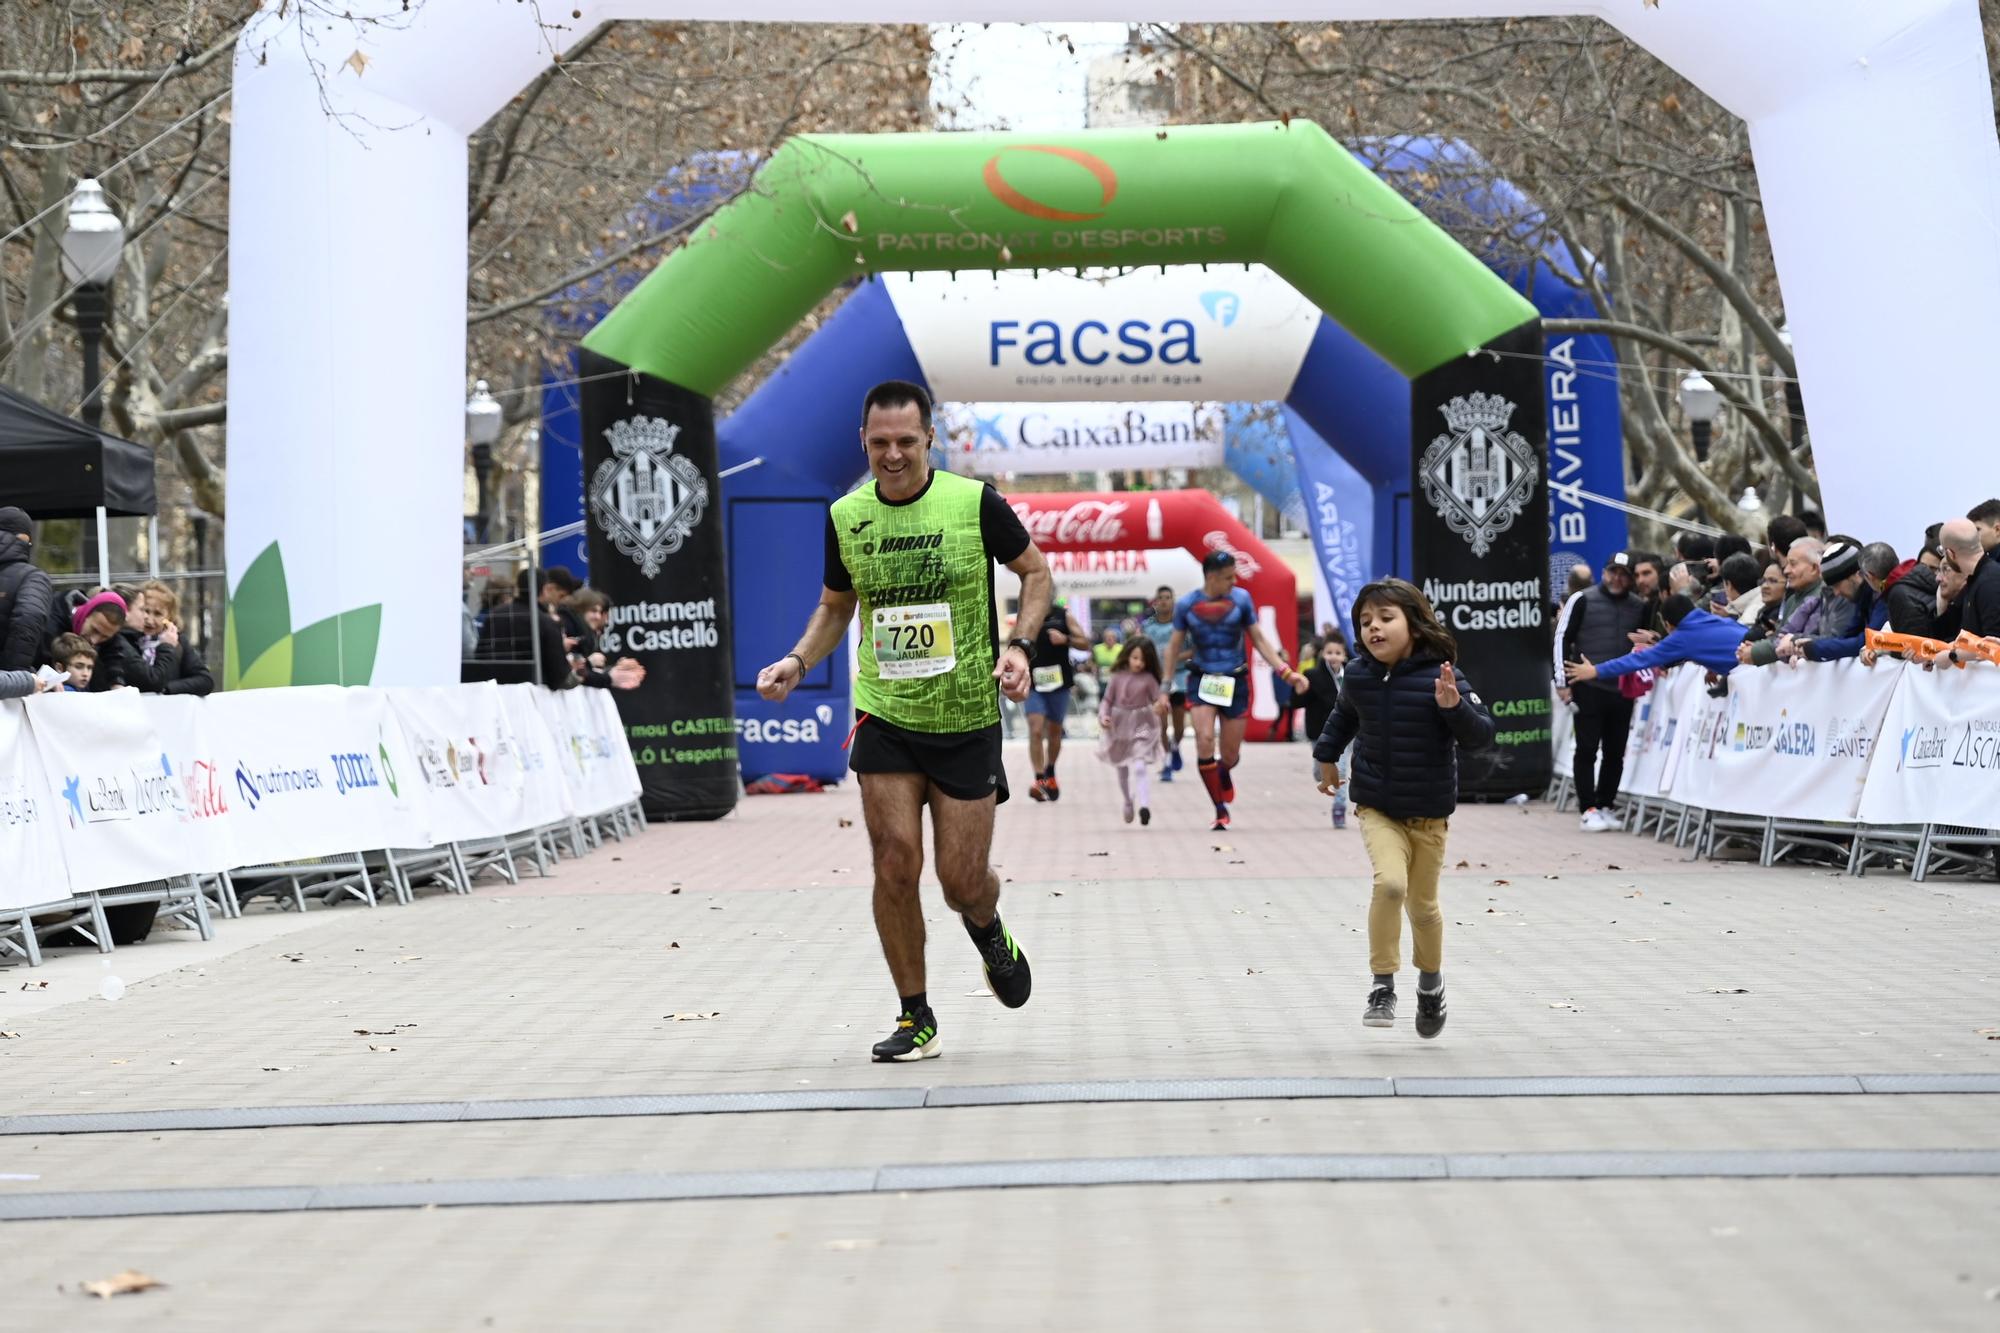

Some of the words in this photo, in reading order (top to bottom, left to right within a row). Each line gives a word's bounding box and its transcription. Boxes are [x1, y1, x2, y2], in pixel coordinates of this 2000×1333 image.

[877, 231, 1040, 251] PATRONAT
[1052, 227, 1226, 249] D'ESPORTS
[1060, 374, 1125, 386] integral
[1130, 374, 1157, 385] del
[1550, 337, 1587, 544] BAVIERA
[878, 529, 944, 553] MARATÓ
[1048, 550, 1149, 573] AMAHA
[1422, 576, 1541, 609] Ajuntament
[606, 598, 716, 631] juntament
[1430, 603, 1447, 628] e
[1451, 600, 1542, 631] Castelló
[626, 620, 719, 652] Castelló
[888, 624, 935, 651] 720
[896, 649, 930, 661] JAUME
[256, 764, 323, 794] nutrinovex
